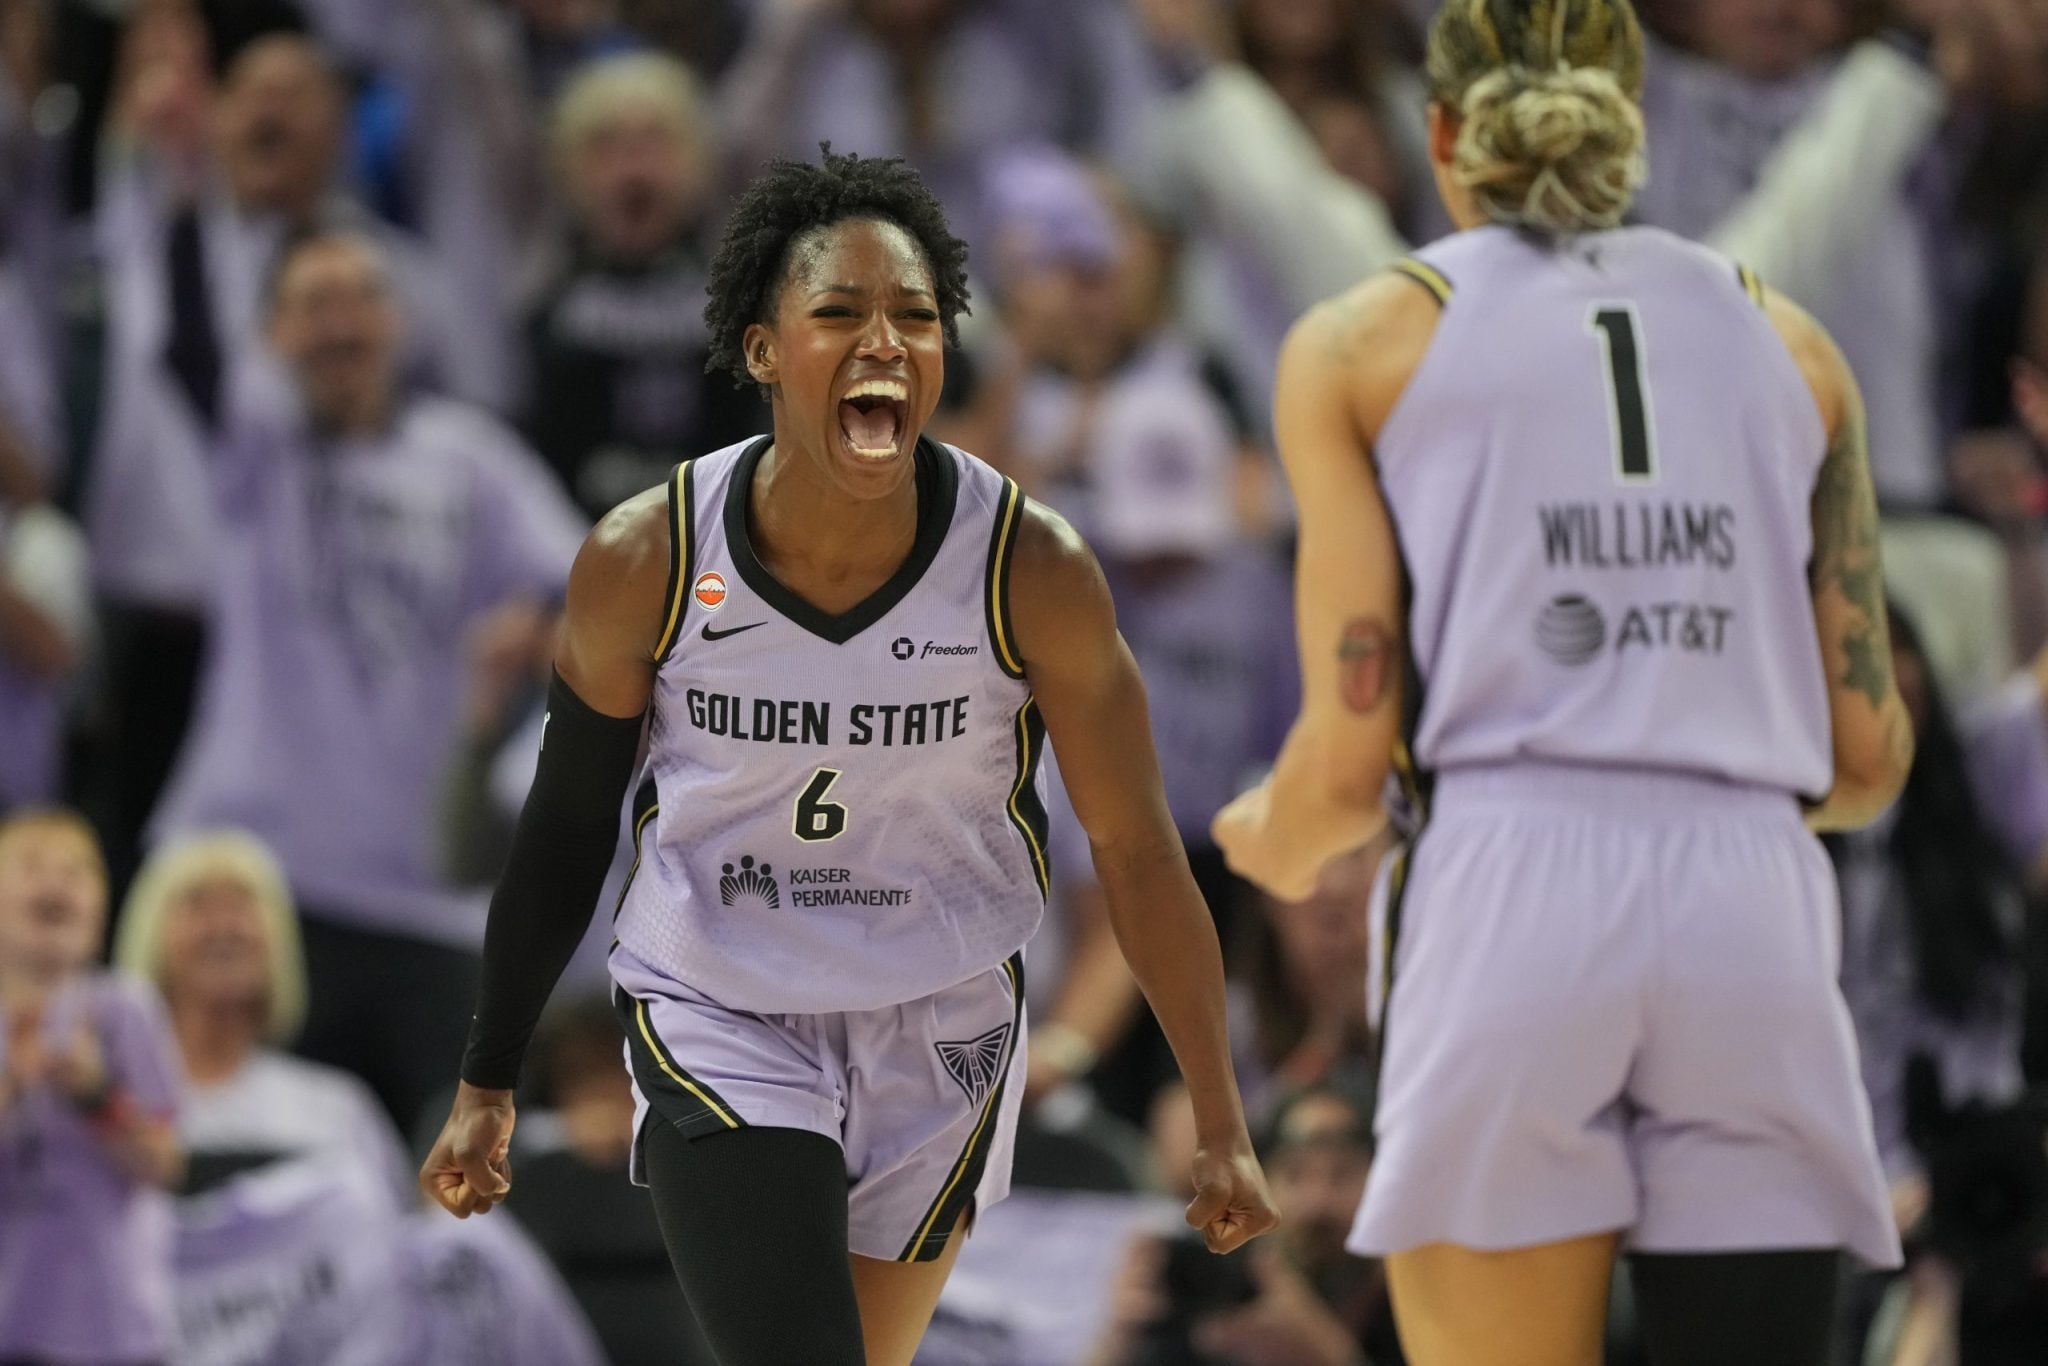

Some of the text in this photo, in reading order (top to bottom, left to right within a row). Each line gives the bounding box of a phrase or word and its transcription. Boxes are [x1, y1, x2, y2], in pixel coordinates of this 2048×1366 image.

[1588, 304, 1657, 483] 1
[1538, 501, 1736, 571] WILLIAMS
[920, 641, 978, 659] freedom
[1614, 602, 1736, 655] AT&T
[687, 688, 970, 746] GOLDEN STATE
[792, 767, 848, 842] 6
[790, 868, 851, 885] KAISER
[791, 888, 913, 907] PERMANENTE
